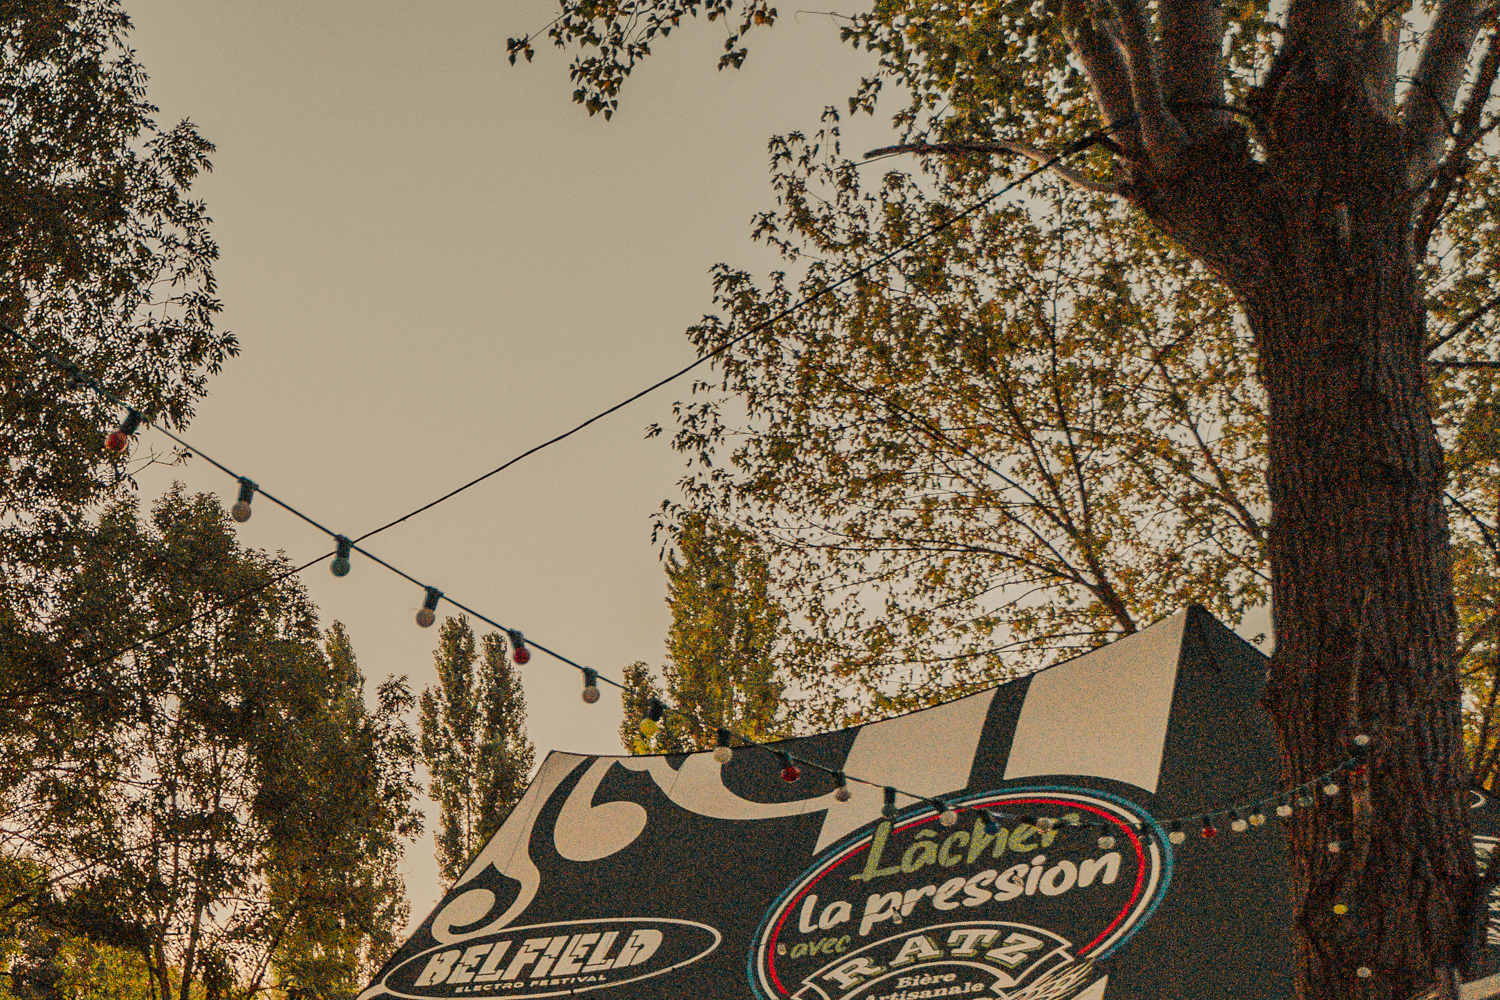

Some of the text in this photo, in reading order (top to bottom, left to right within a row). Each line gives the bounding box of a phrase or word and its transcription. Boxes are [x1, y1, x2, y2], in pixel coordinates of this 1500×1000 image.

[850, 813, 1080, 882] Lâcher
[799, 852, 1122, 936] la pression
[413, 929, 663, 988] BELFIELD
[790, 934, 851, 960] avec
[822, 928, 1045, 991] RATZ
[454, 974, 607, 994] ELECTRO FESTIVAL
[895, 972, 957, 989] Bière
